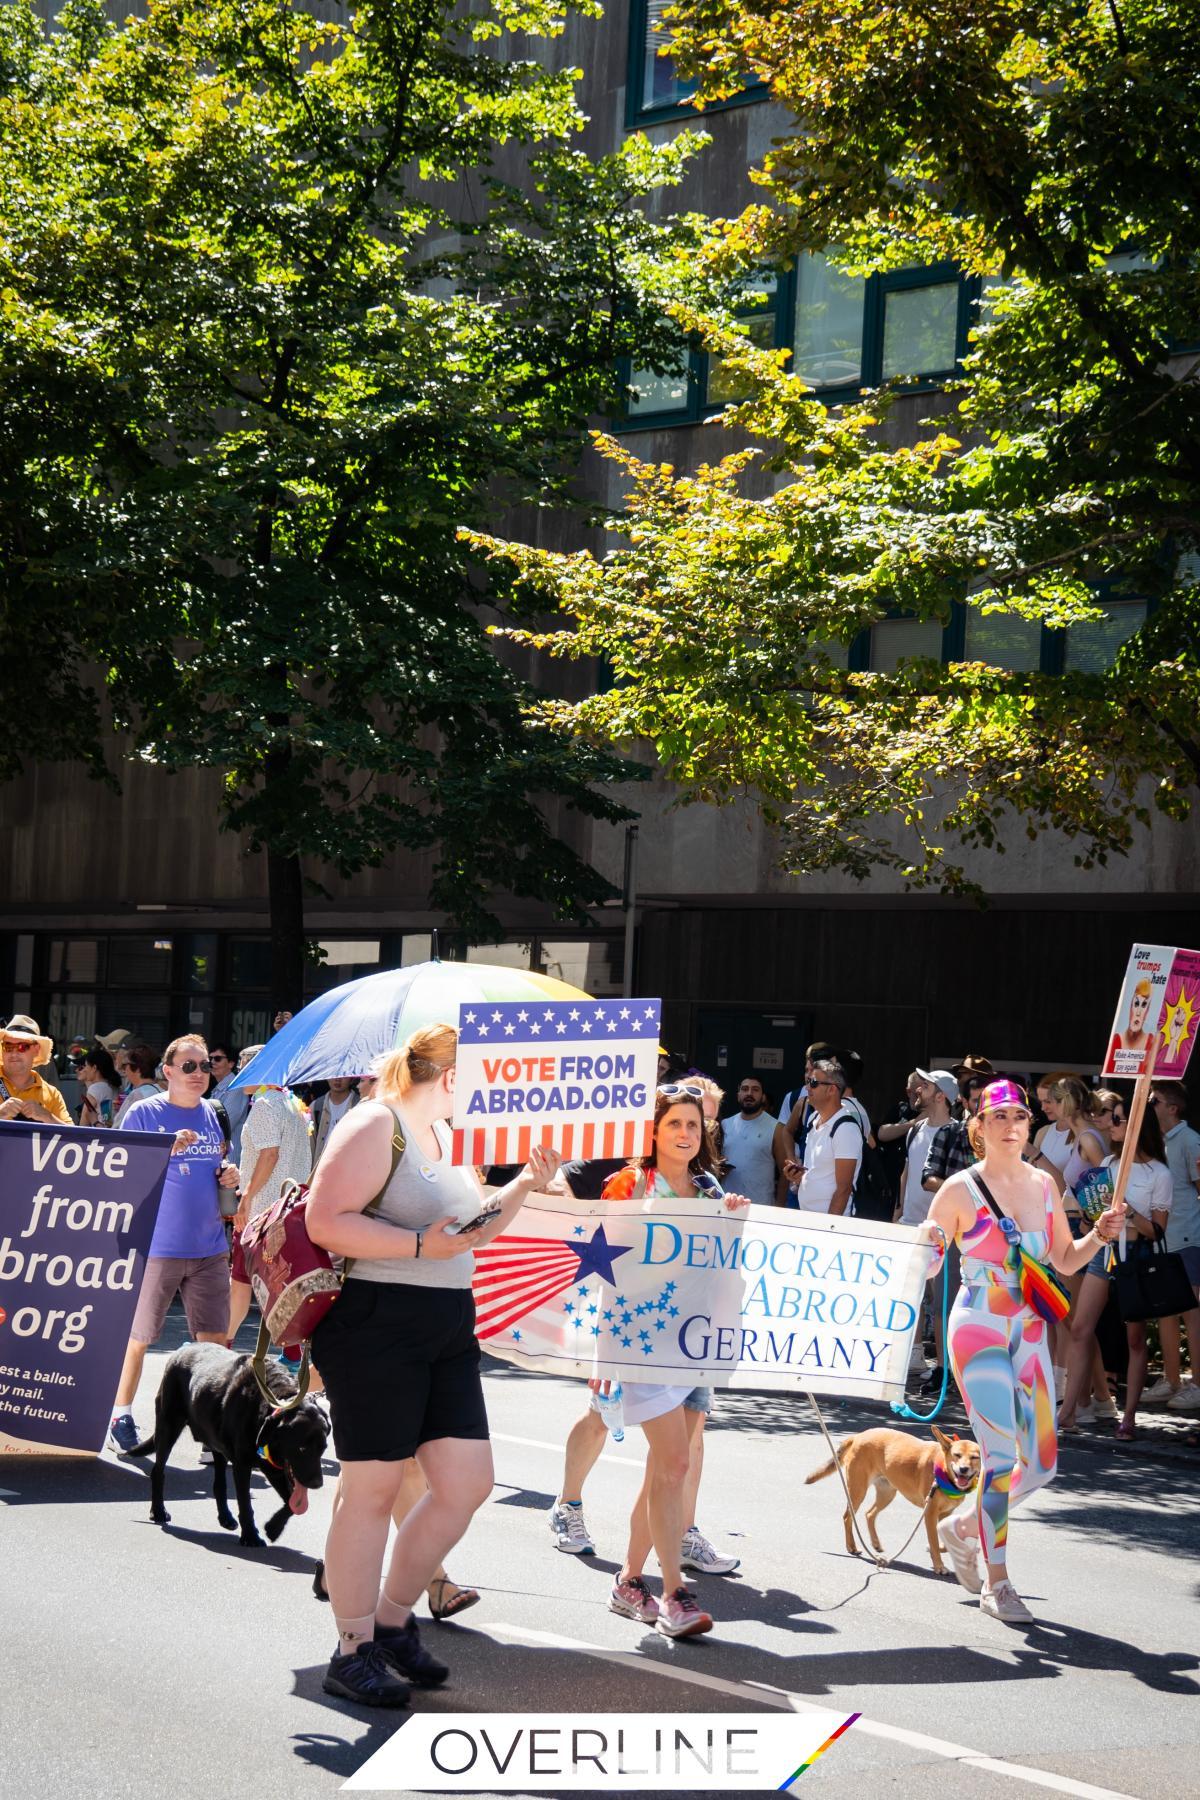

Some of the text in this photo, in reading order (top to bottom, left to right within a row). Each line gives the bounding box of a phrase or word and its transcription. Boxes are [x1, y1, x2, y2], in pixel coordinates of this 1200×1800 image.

[1134, 948, 1150, 960] Love
[1136, 961, 1161, 973] trumps
[1151, 973, 1167, 985] hate
[482, 1054, 635, 1083] VOTE FROM
[466, 1083, 647, 1115] ABROAD.ORG
[32, 1132, 128, 1178] Vote
[20, 1184, 134, 1237] from
[638, 1222, 892, 1286] DEMOCRATS
[739, 1274, 916, 1332] ABROAD
[678, 1315, 891, 1373] GERMANY
[22, 1370, 31, 1380] a
[34, 1369, 76, 1387] ballot.
[12, 1387, 44, 1401] mail.
[0, 1401, 68, 1423] the future.
